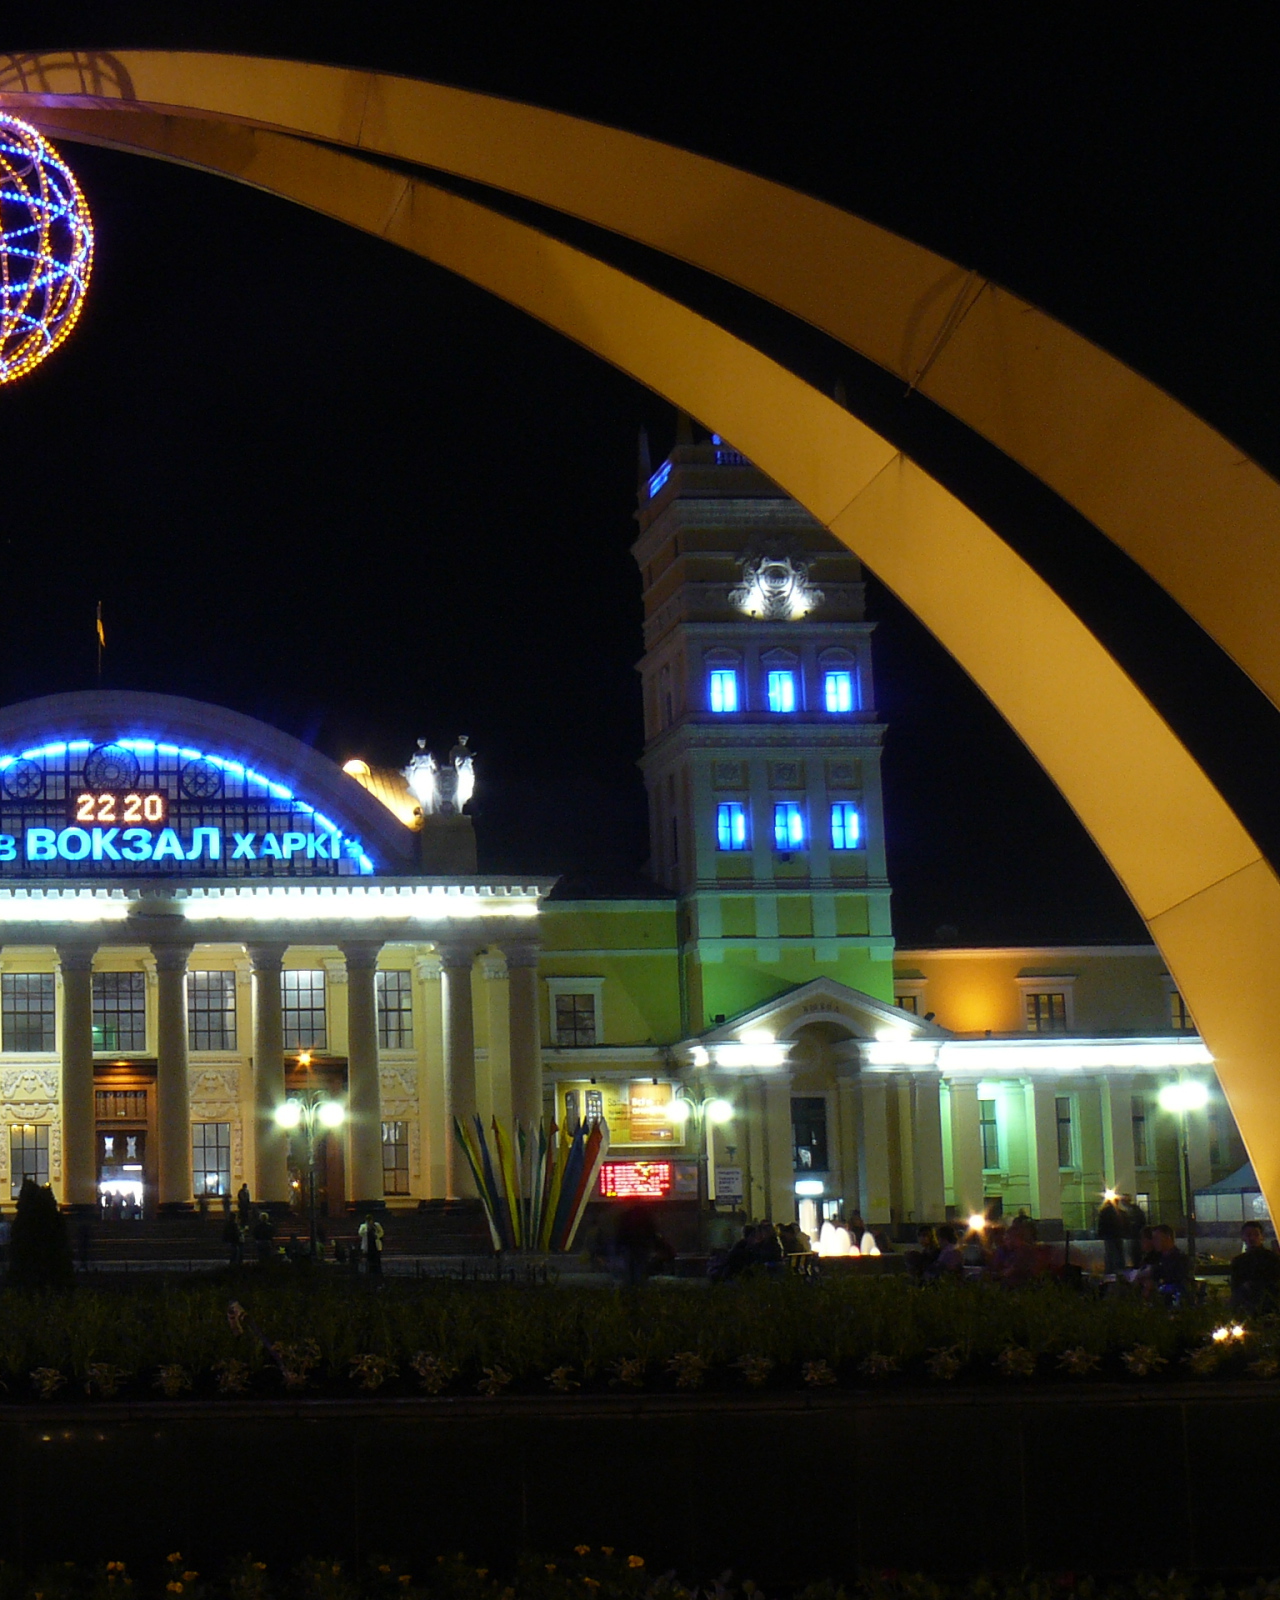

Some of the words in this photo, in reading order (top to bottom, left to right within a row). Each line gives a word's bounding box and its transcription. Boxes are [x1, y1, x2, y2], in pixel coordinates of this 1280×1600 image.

[76, 794, 116, 822] 22
[124, 794, 163, 822] 20
[27, 826, 220, 861] ВОКЗАЛ
